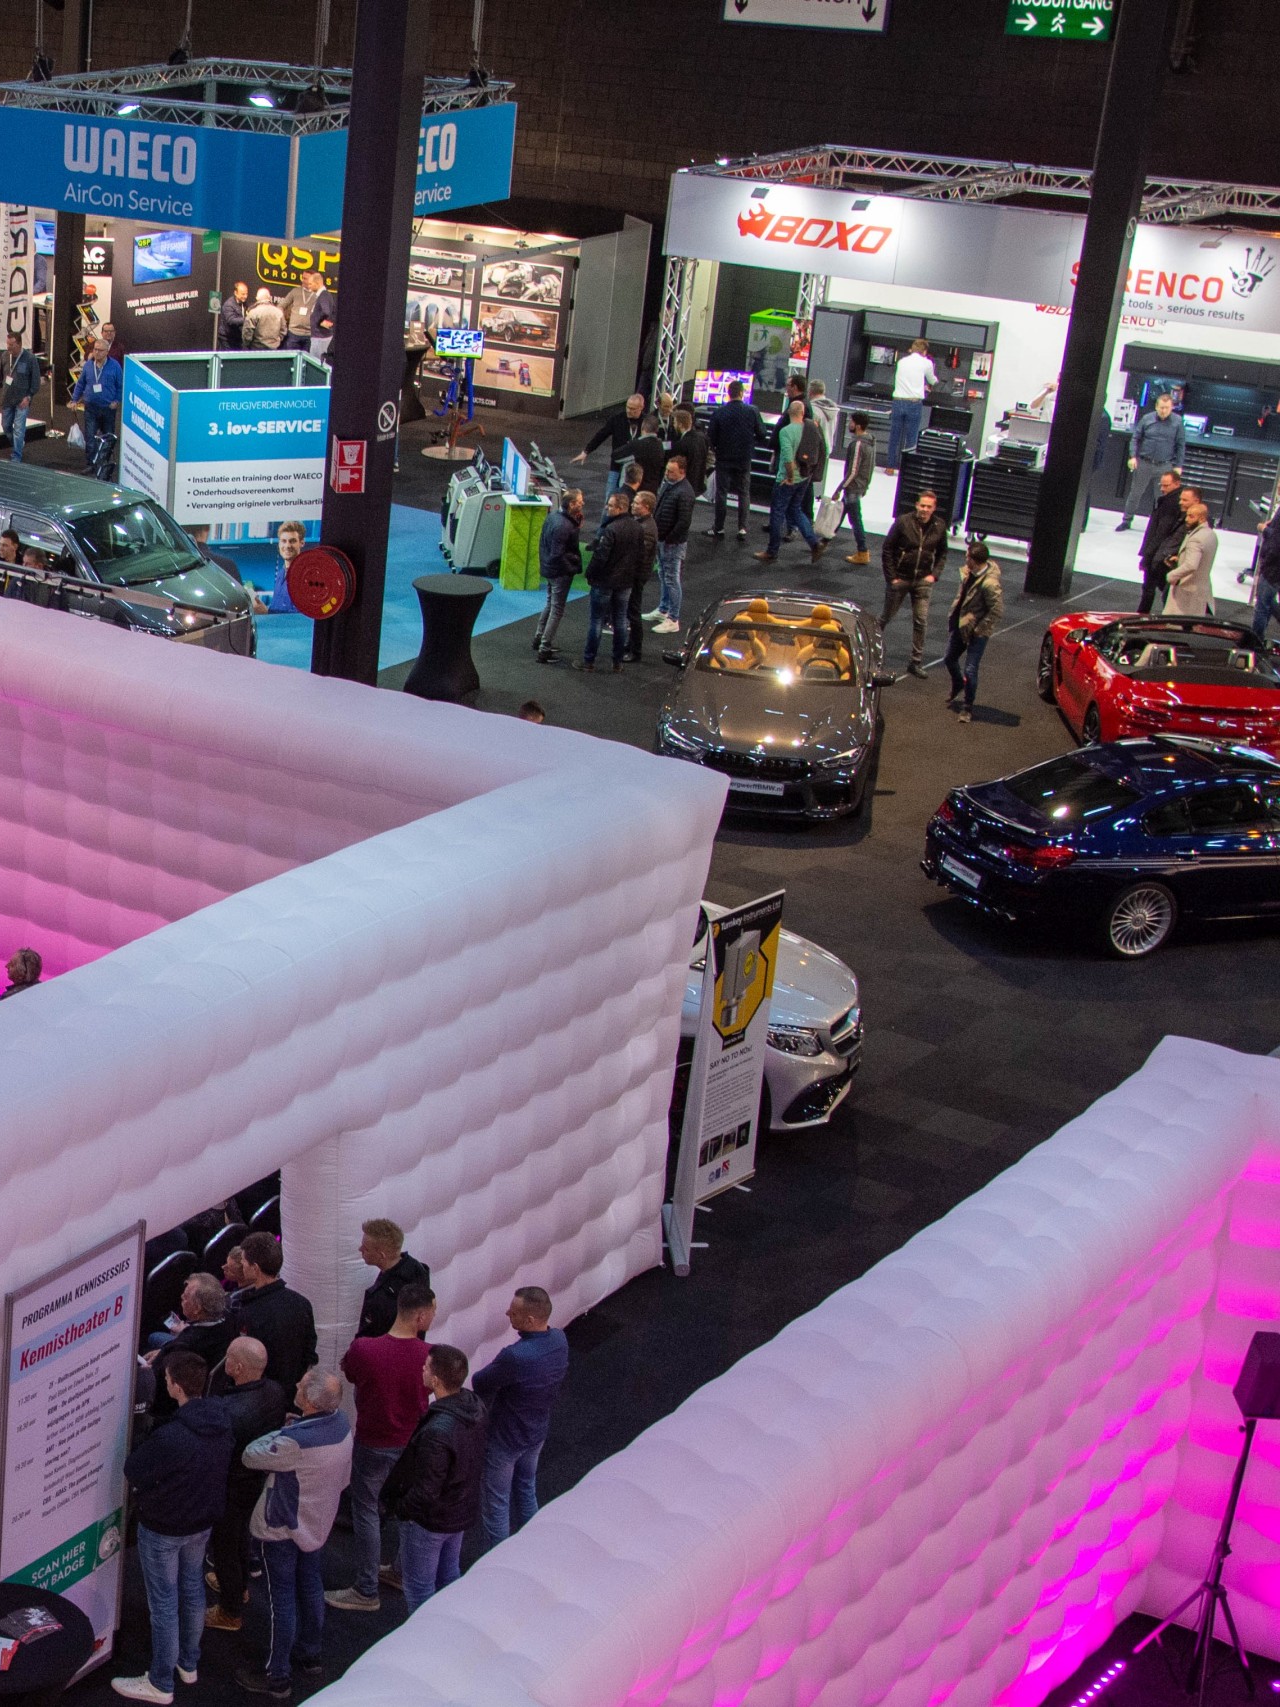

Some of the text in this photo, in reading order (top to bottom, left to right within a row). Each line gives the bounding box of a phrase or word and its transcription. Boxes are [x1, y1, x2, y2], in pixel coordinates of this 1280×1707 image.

[64, 123, 197, 186] WAECO
[64, 182, 194, 217] AirCon Service
[414, 182, 453, 206] ervice
[765, 215, 893, 254] BOXO
[126, 290, 199, 309] YOUR PROFESSIONAL SUPPLIER
[135, 301, 190, 316] FOR VARIOUS MARKETS
[1128, 299, 1246, 322] tools serious results
[218, 399, 317, 412] (TERUG)VERDIENMODEL
[208, 422, 224, 436] 3.
[192, 475, 231, 484] Installatie
[242, 474, 272, 485] training
[273, 472, 292, 481] door
[293, 471, 323, 481] WAECO
[192, 486, 295, 497] Onderhoudsovereenkomst
[191, 500, 236, 510] Vervanging
[237, 499, 271, 510] originele
[721, 916, 744, 932] Turnkey
[743, 904, 772, 923] Instruments
[709, 1059, 721, 1071] SAY
[721, 1054, 731, 1066] NO
[730, 1050, 739, 1062] TO
[22, 1257, 131, 1330] PROGRAMMA KENNISSESSIES
[20, 1295, 124, 1372] Kennistheater B
[31, 1541, 86, 1584] SCAN HIER
[51, 1555, 86, 1586] BADGE
